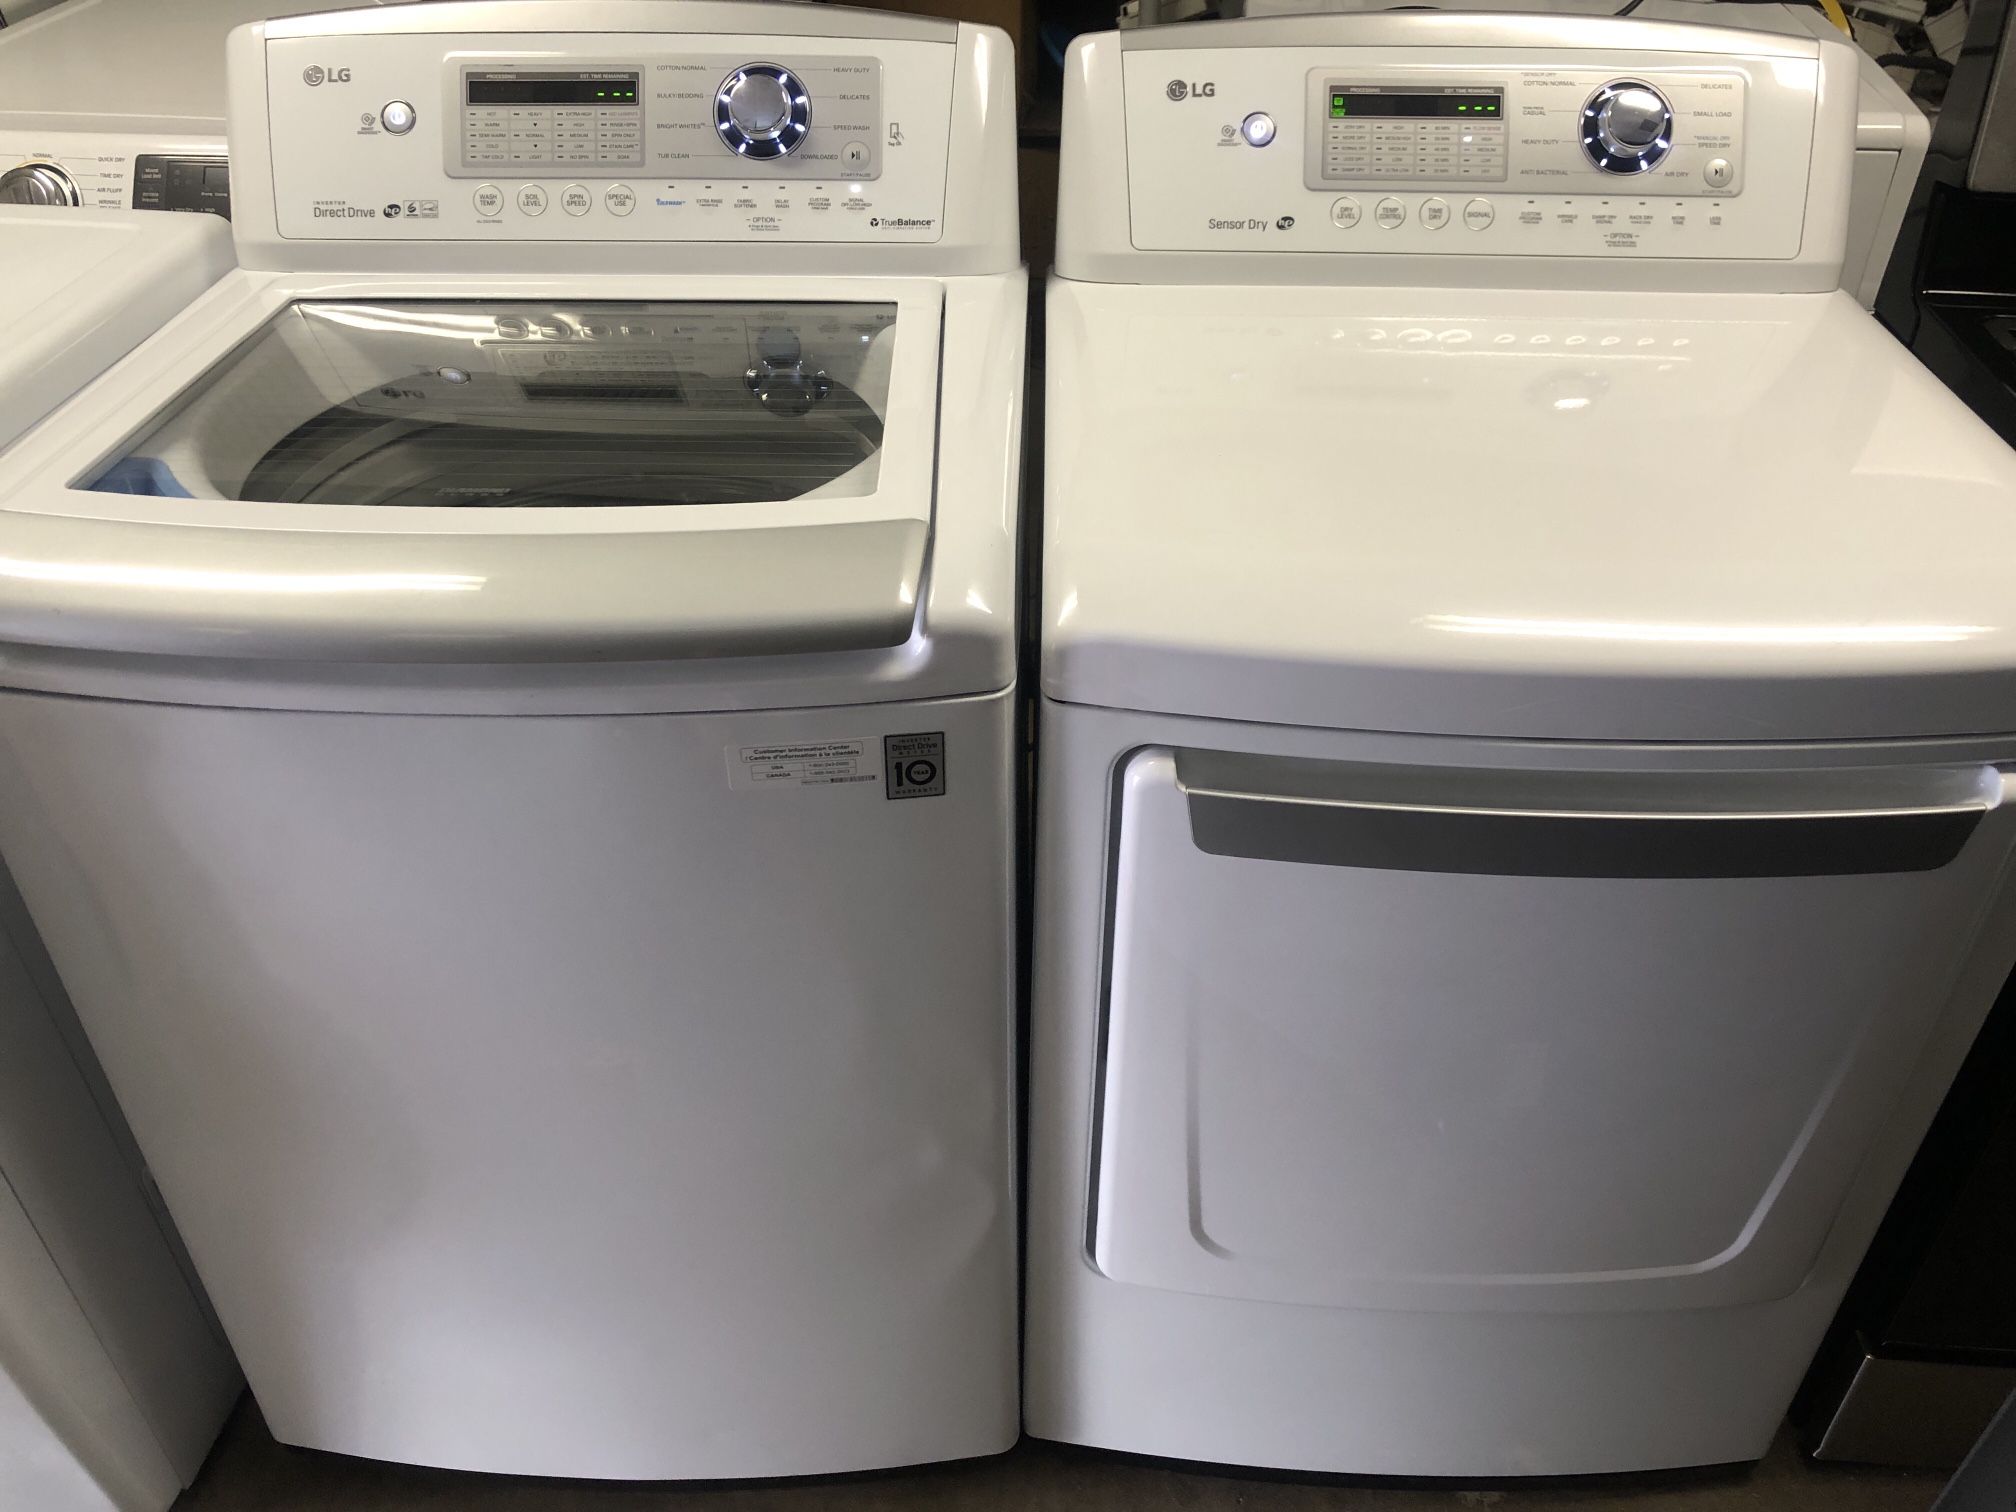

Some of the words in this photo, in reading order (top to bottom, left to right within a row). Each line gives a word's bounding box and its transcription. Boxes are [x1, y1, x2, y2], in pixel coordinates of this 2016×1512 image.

[327, 68, 351, 83] LG
[1192, 82, 1215, 97] LG
[314, 207, 346, 218] Direct
[347, 207, 376, 218] Drive
[1208, 218, 1245, 230] Sensor
[1248, 218, 1268, 232] Dry
[788, 745, 827, 753] Information
[917, 742, 938, 750] Drive
[895, 760, 937, 787] 10
